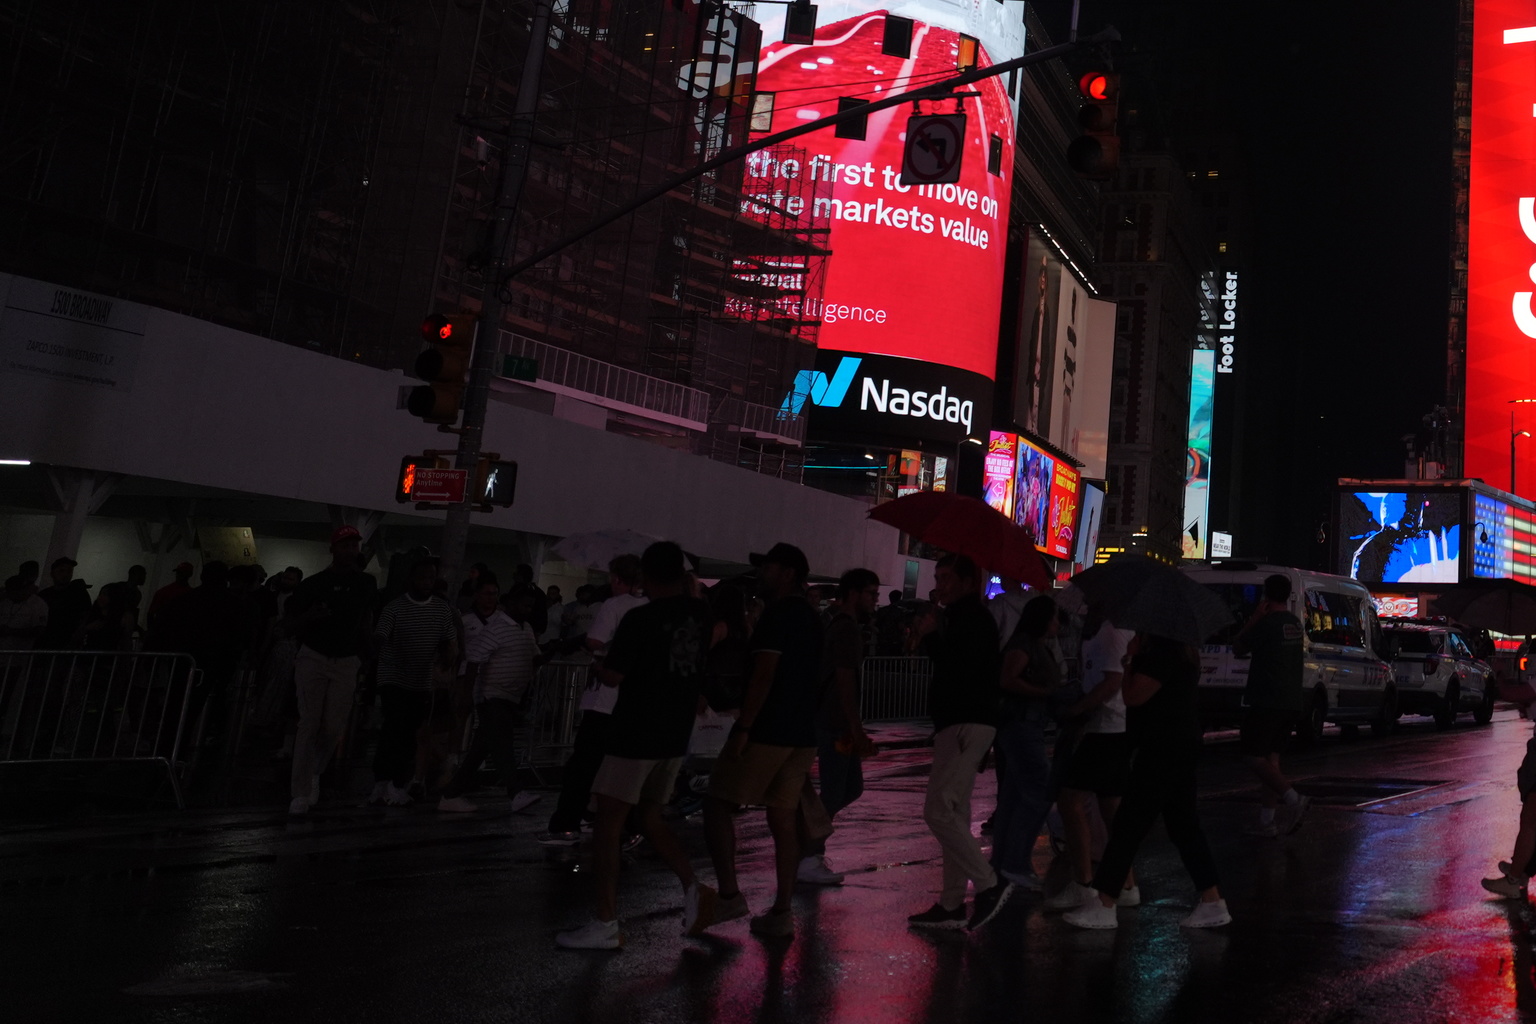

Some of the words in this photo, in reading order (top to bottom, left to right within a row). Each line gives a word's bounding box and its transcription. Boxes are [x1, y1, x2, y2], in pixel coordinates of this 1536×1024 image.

[748, 150, 800, 180] the
[808, 154, 875, 188] first
[980, 194, 999, 220] on
[812, 197, 935, 235] markets
[939, 217, 989, 250] value
[69, 294, 113, 324] BROADWAY
[1217, 335, 1235, 374] Foot
[860, 377, 973, 435] Nasdaq
[416, 470, 426, 478] NO
[428, 470, 460, 479] STOPPING
[416, 479, 443, 488] Anytime
